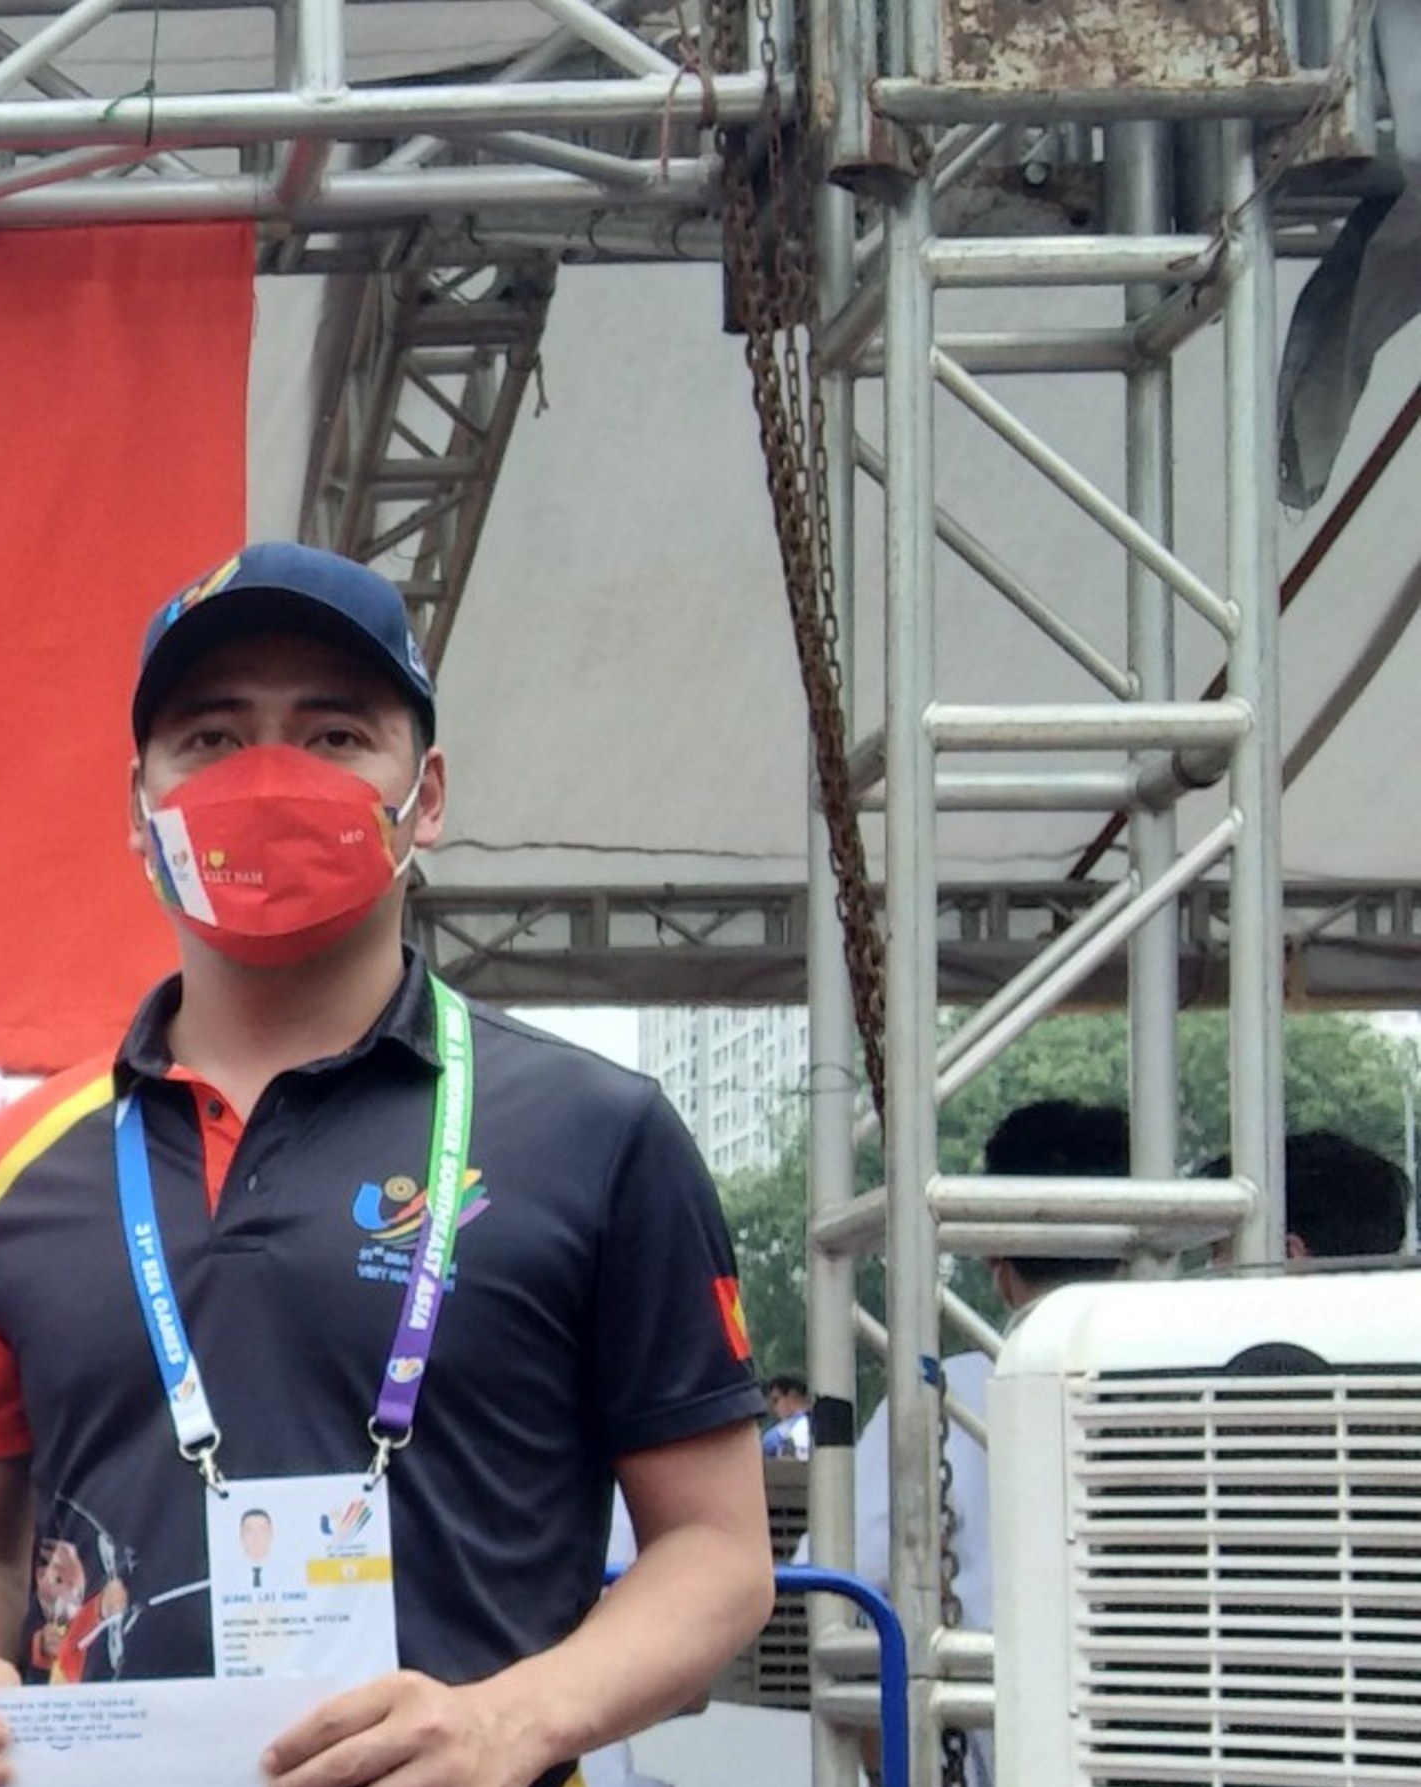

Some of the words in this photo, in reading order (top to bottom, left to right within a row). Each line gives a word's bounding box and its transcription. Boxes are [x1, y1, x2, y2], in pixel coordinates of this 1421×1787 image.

[423, 1154, 458, 1279] SOUTHEAST
[141, 1259, 164, 1296] SEA
[408, 1273, 436, 1330] ASIA
[151, 1297, 185, 1365] GAMES
